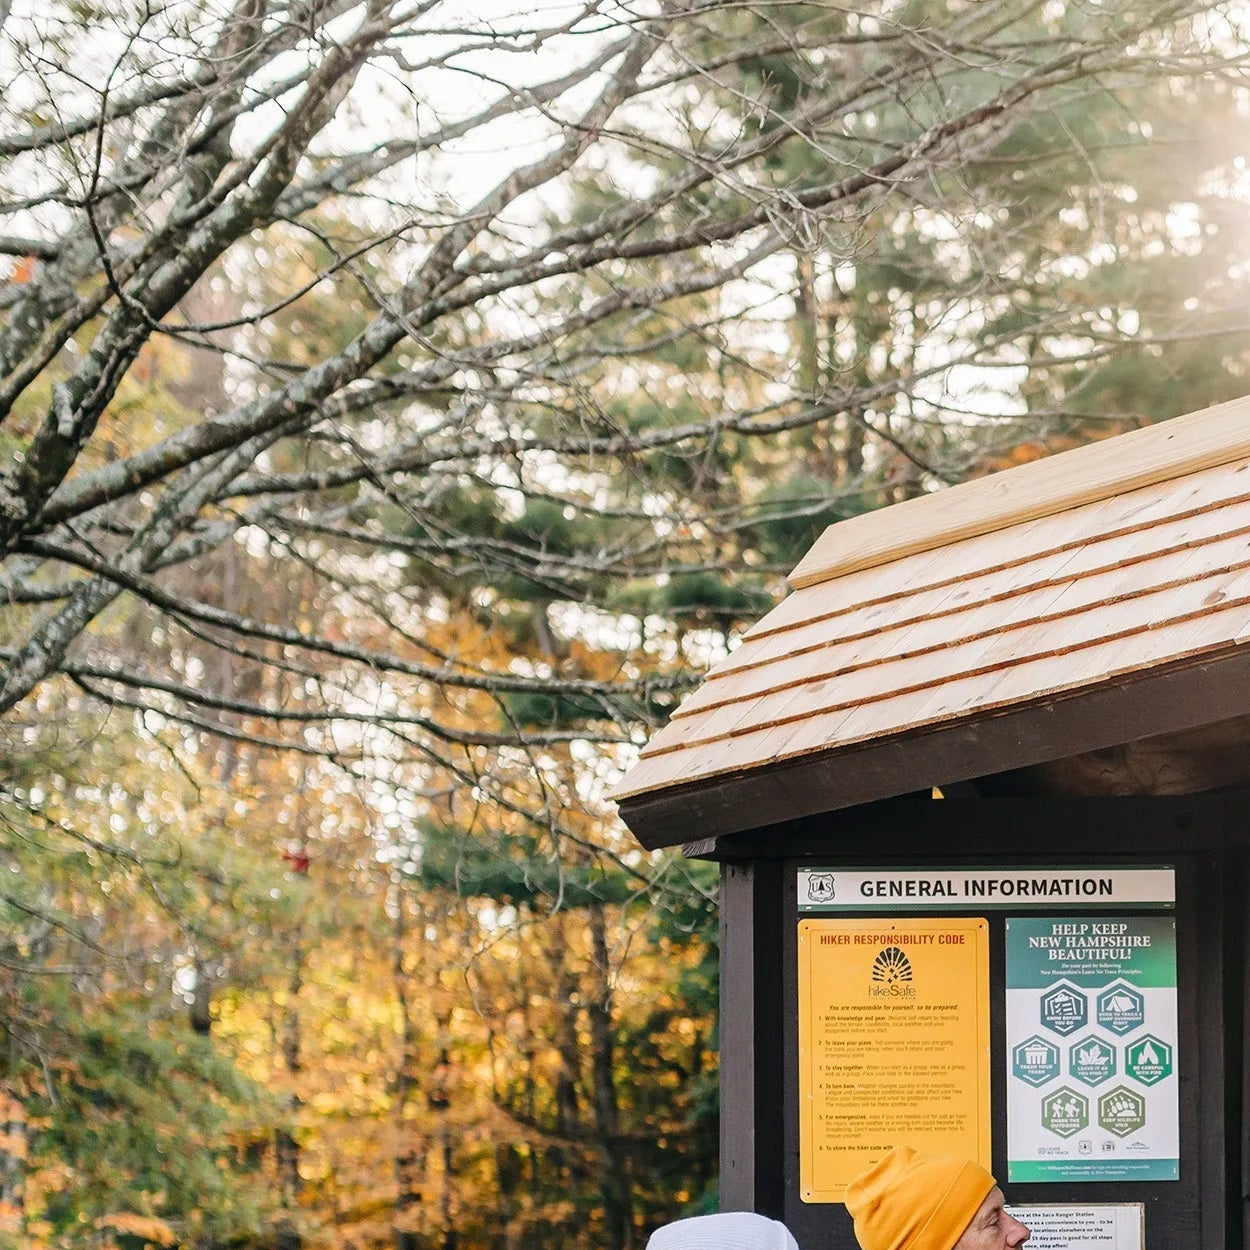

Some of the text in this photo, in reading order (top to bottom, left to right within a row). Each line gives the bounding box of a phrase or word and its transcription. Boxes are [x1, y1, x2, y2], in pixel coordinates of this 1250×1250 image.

[860, 878, 1113, 896] GENERAL INFORMATION
[1052, 924, 1128, 935] HELP KEEP
[820, 934, 965, 944] HIKER RESPONSIBILITY CODE
[1028, 936, 1152, 948] NEW HAMPSHIRE
[1048, 948, 1132, 960] BEAUTIFUL!
[868, 985, 916, 996] hikeSafe
